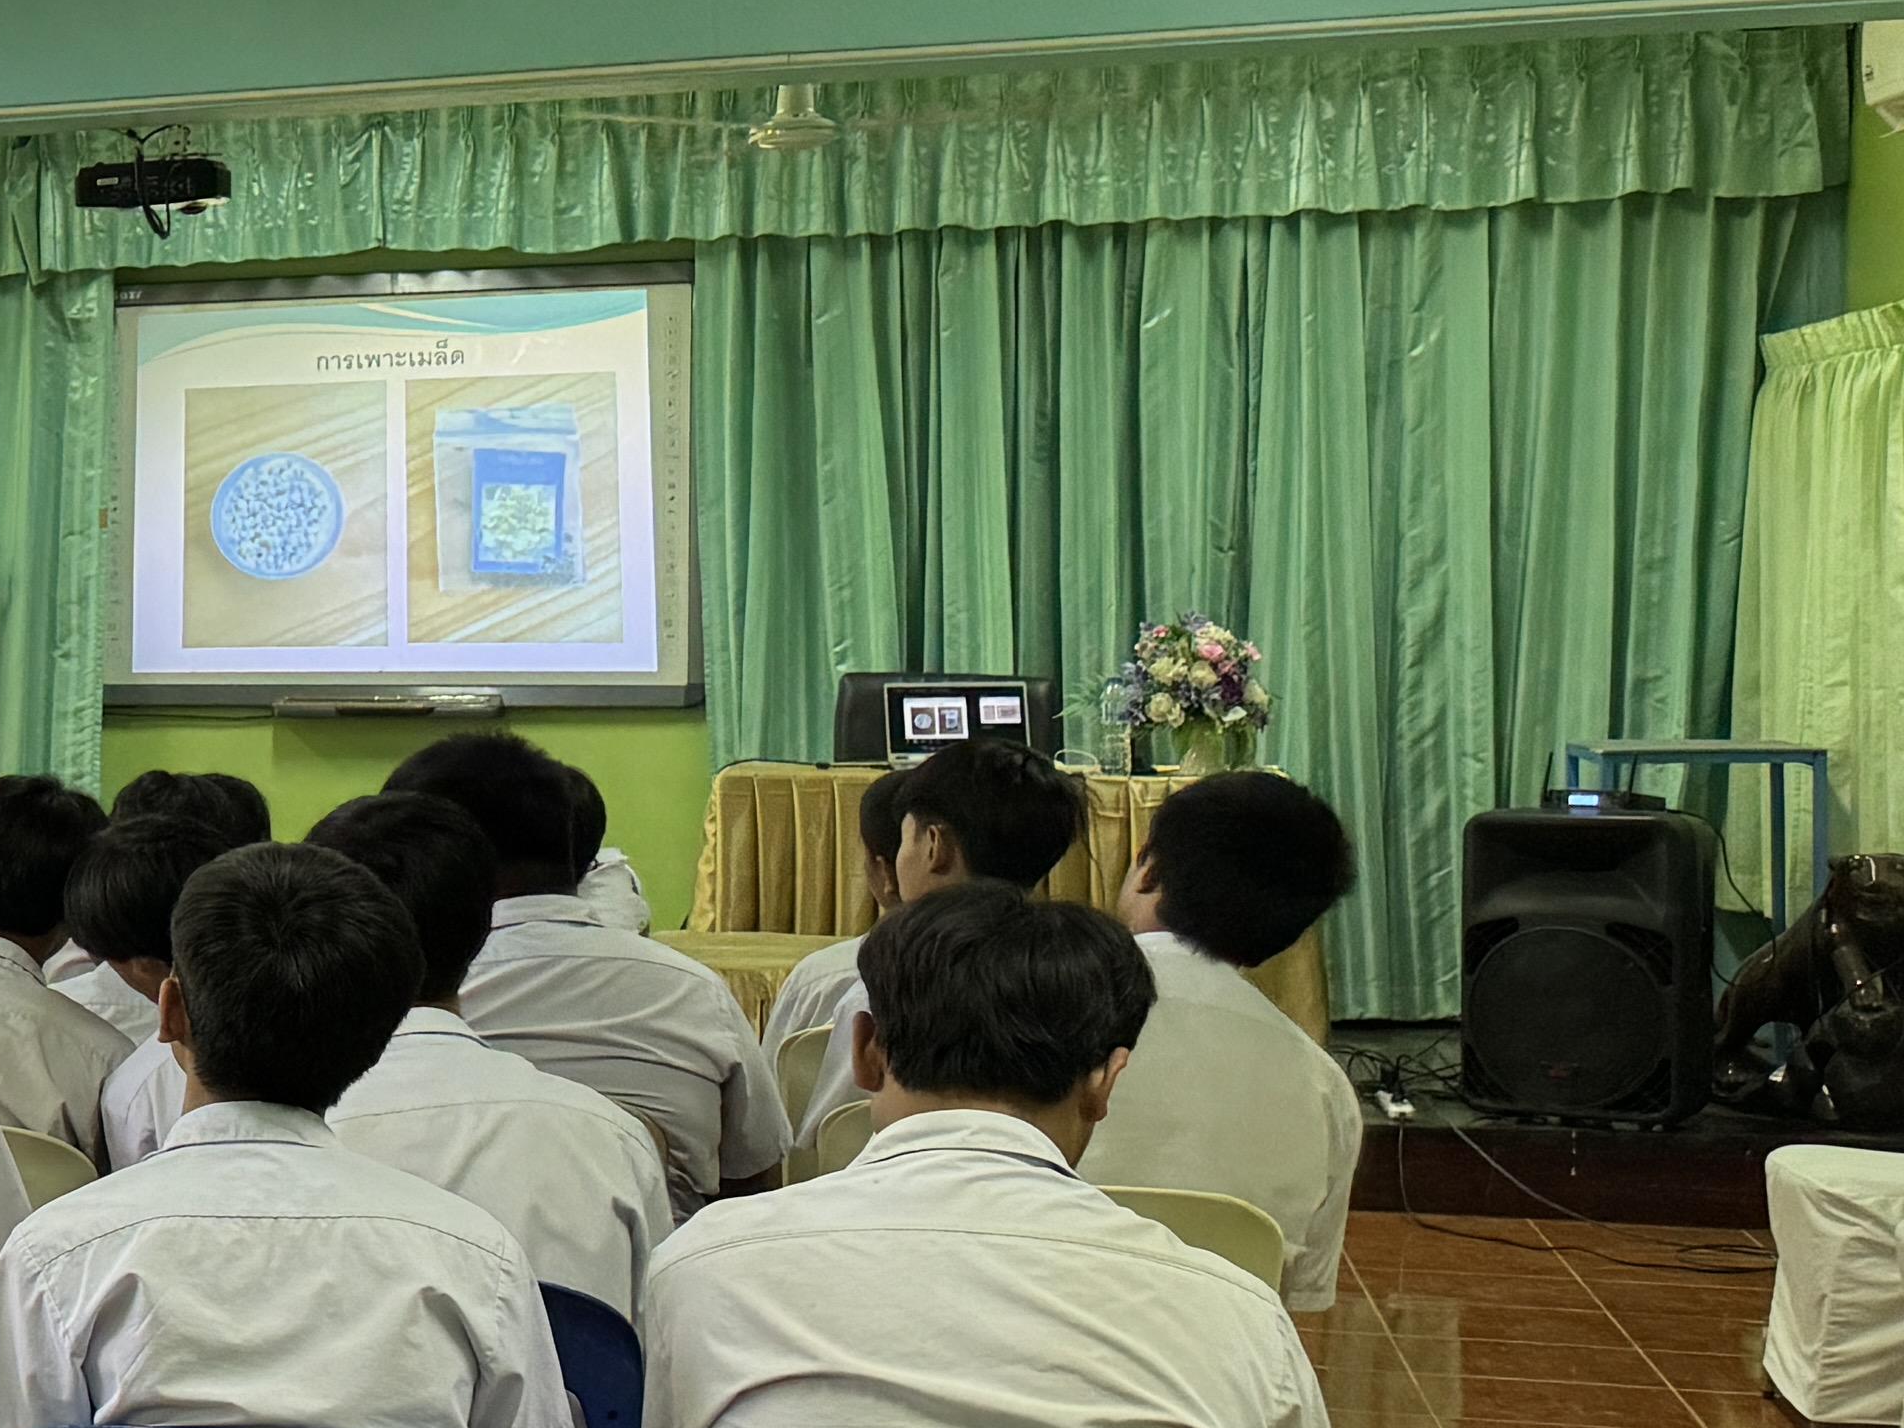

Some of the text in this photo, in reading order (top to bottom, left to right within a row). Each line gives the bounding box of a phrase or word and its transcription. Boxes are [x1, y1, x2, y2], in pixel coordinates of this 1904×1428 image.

[316, 338, 465, 372] การเพาะเมล็ด
